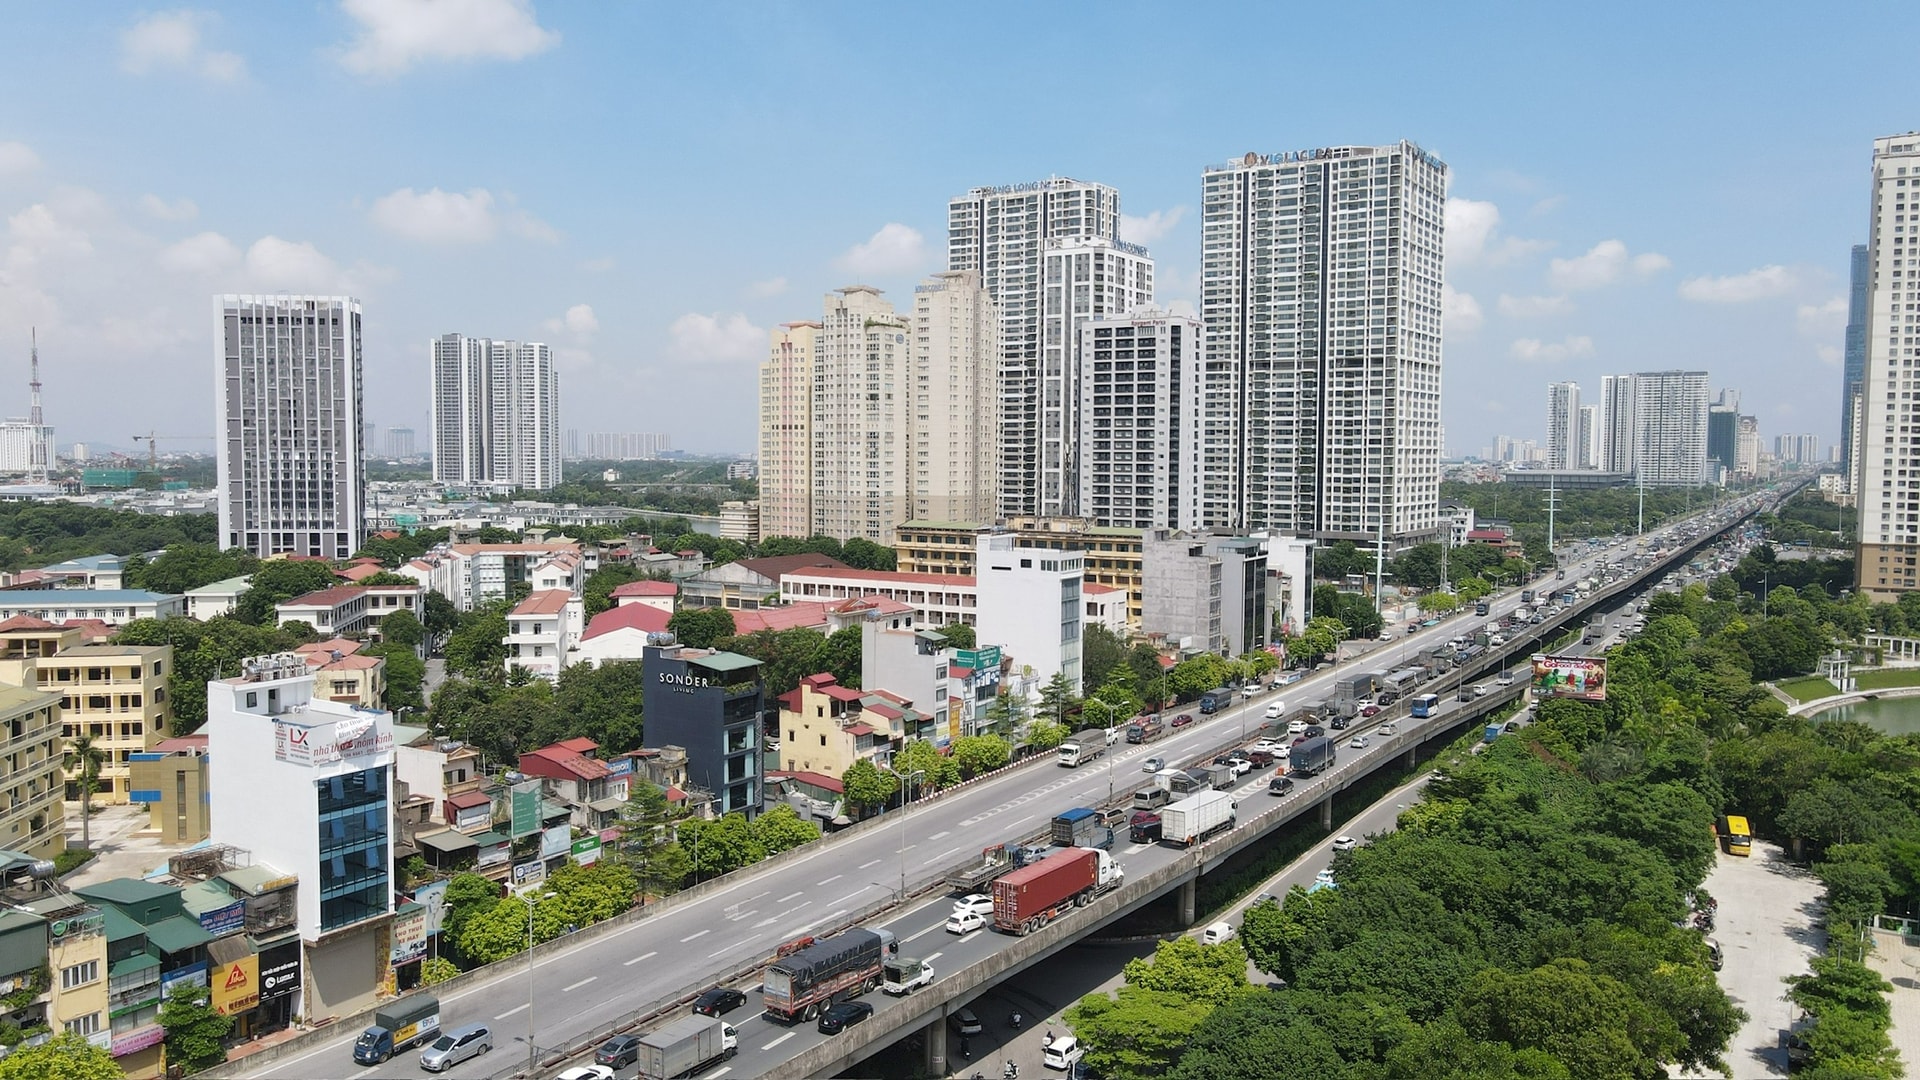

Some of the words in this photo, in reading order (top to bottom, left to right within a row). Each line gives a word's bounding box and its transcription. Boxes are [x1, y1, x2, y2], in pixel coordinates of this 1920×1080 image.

[1260, 147, 1333, 165] VIGLACERA
[1013, 180, 1039, 192] LONG
[659, 672, 709, 688] SONDER
[673, 686, 695, 694] LIVING
[289, 727, 309, 746] LX
